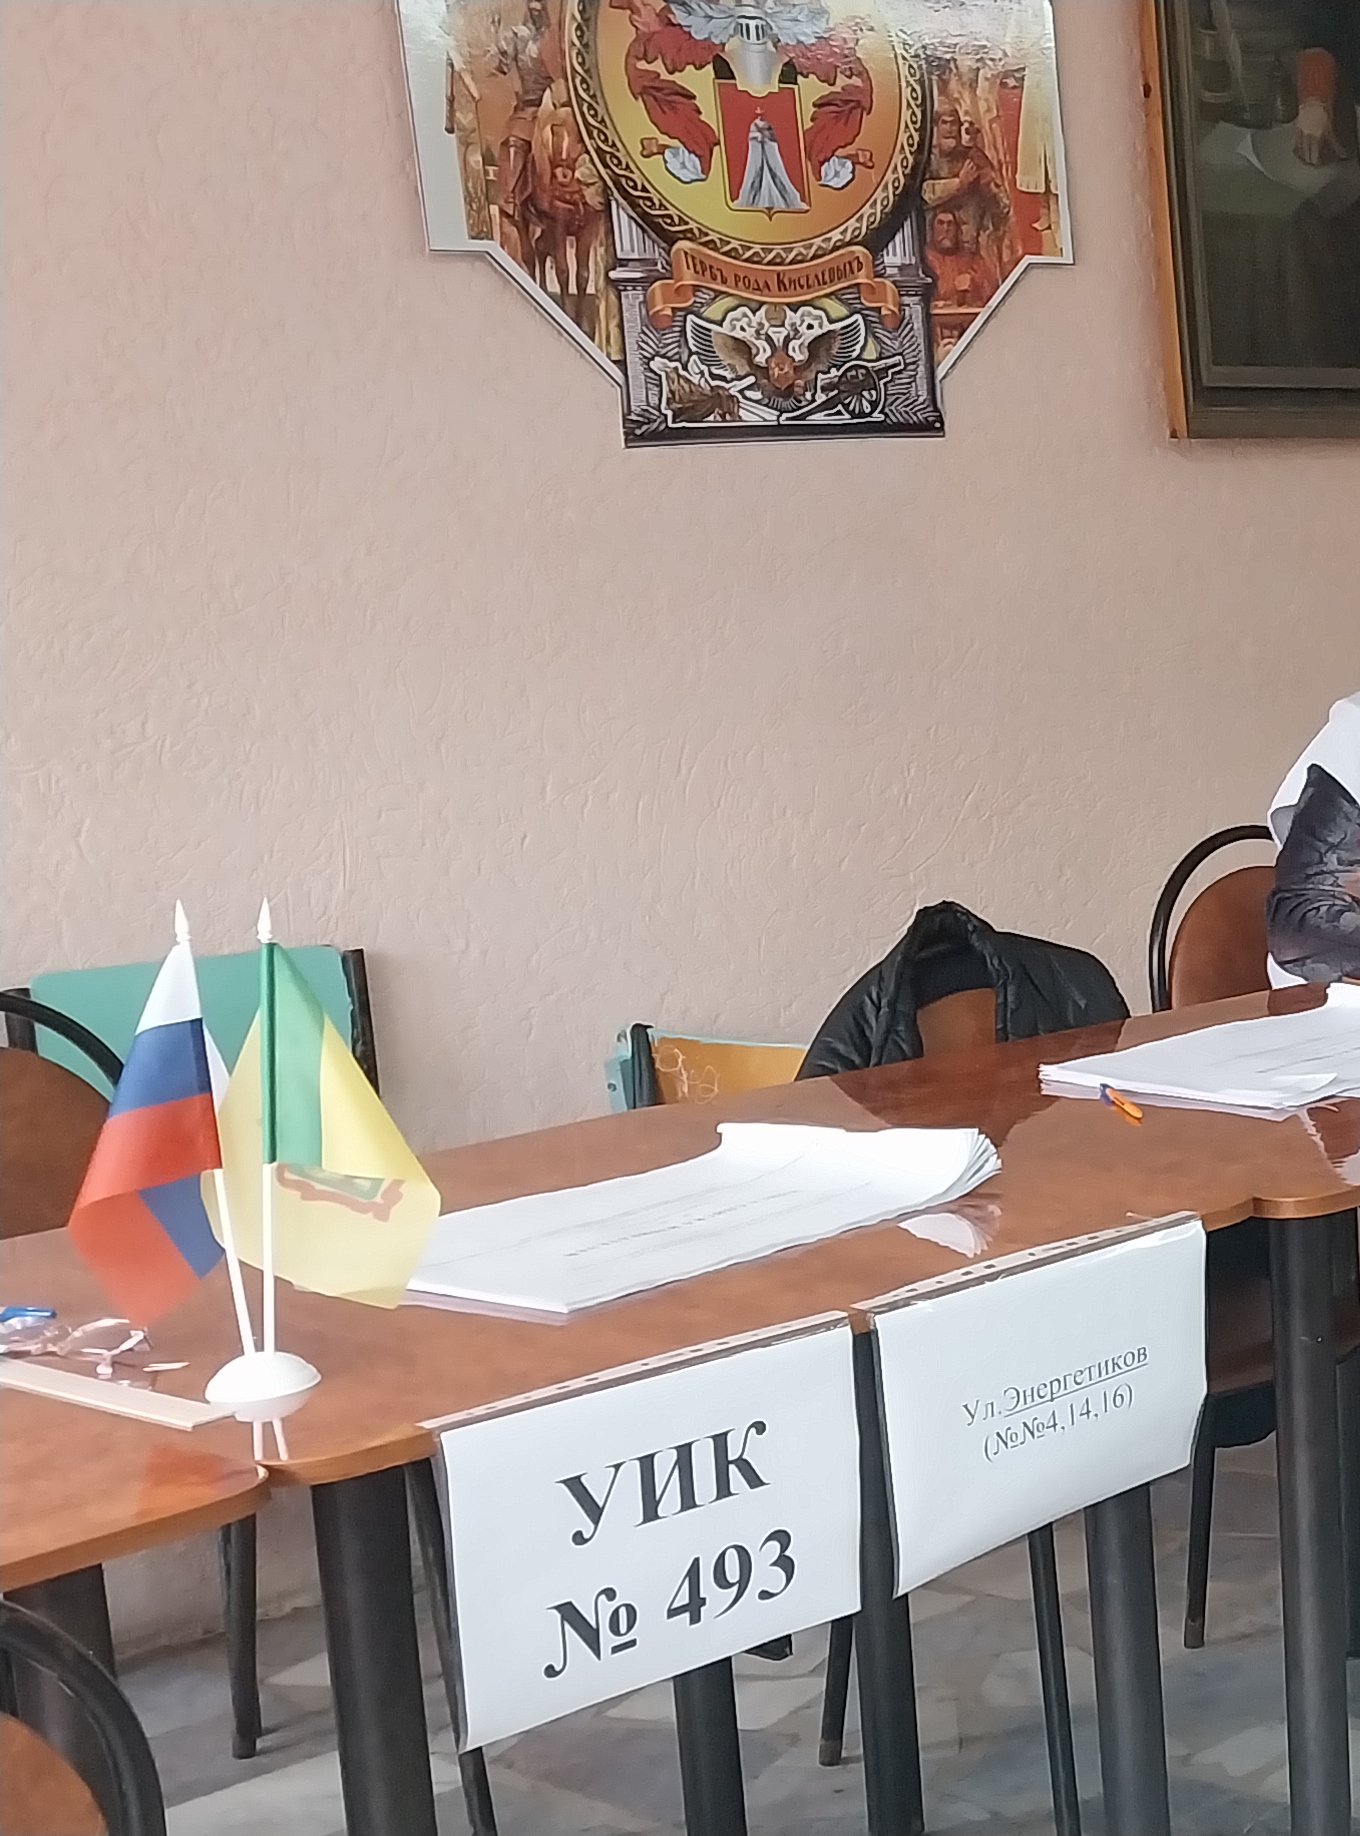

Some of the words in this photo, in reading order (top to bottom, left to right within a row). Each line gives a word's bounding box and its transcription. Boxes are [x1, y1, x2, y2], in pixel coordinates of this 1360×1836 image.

[555, 1418, 771, 1548] УИК
[543, 1586, 639, 1679] №
[665, 1528, 797, 1627] 493
